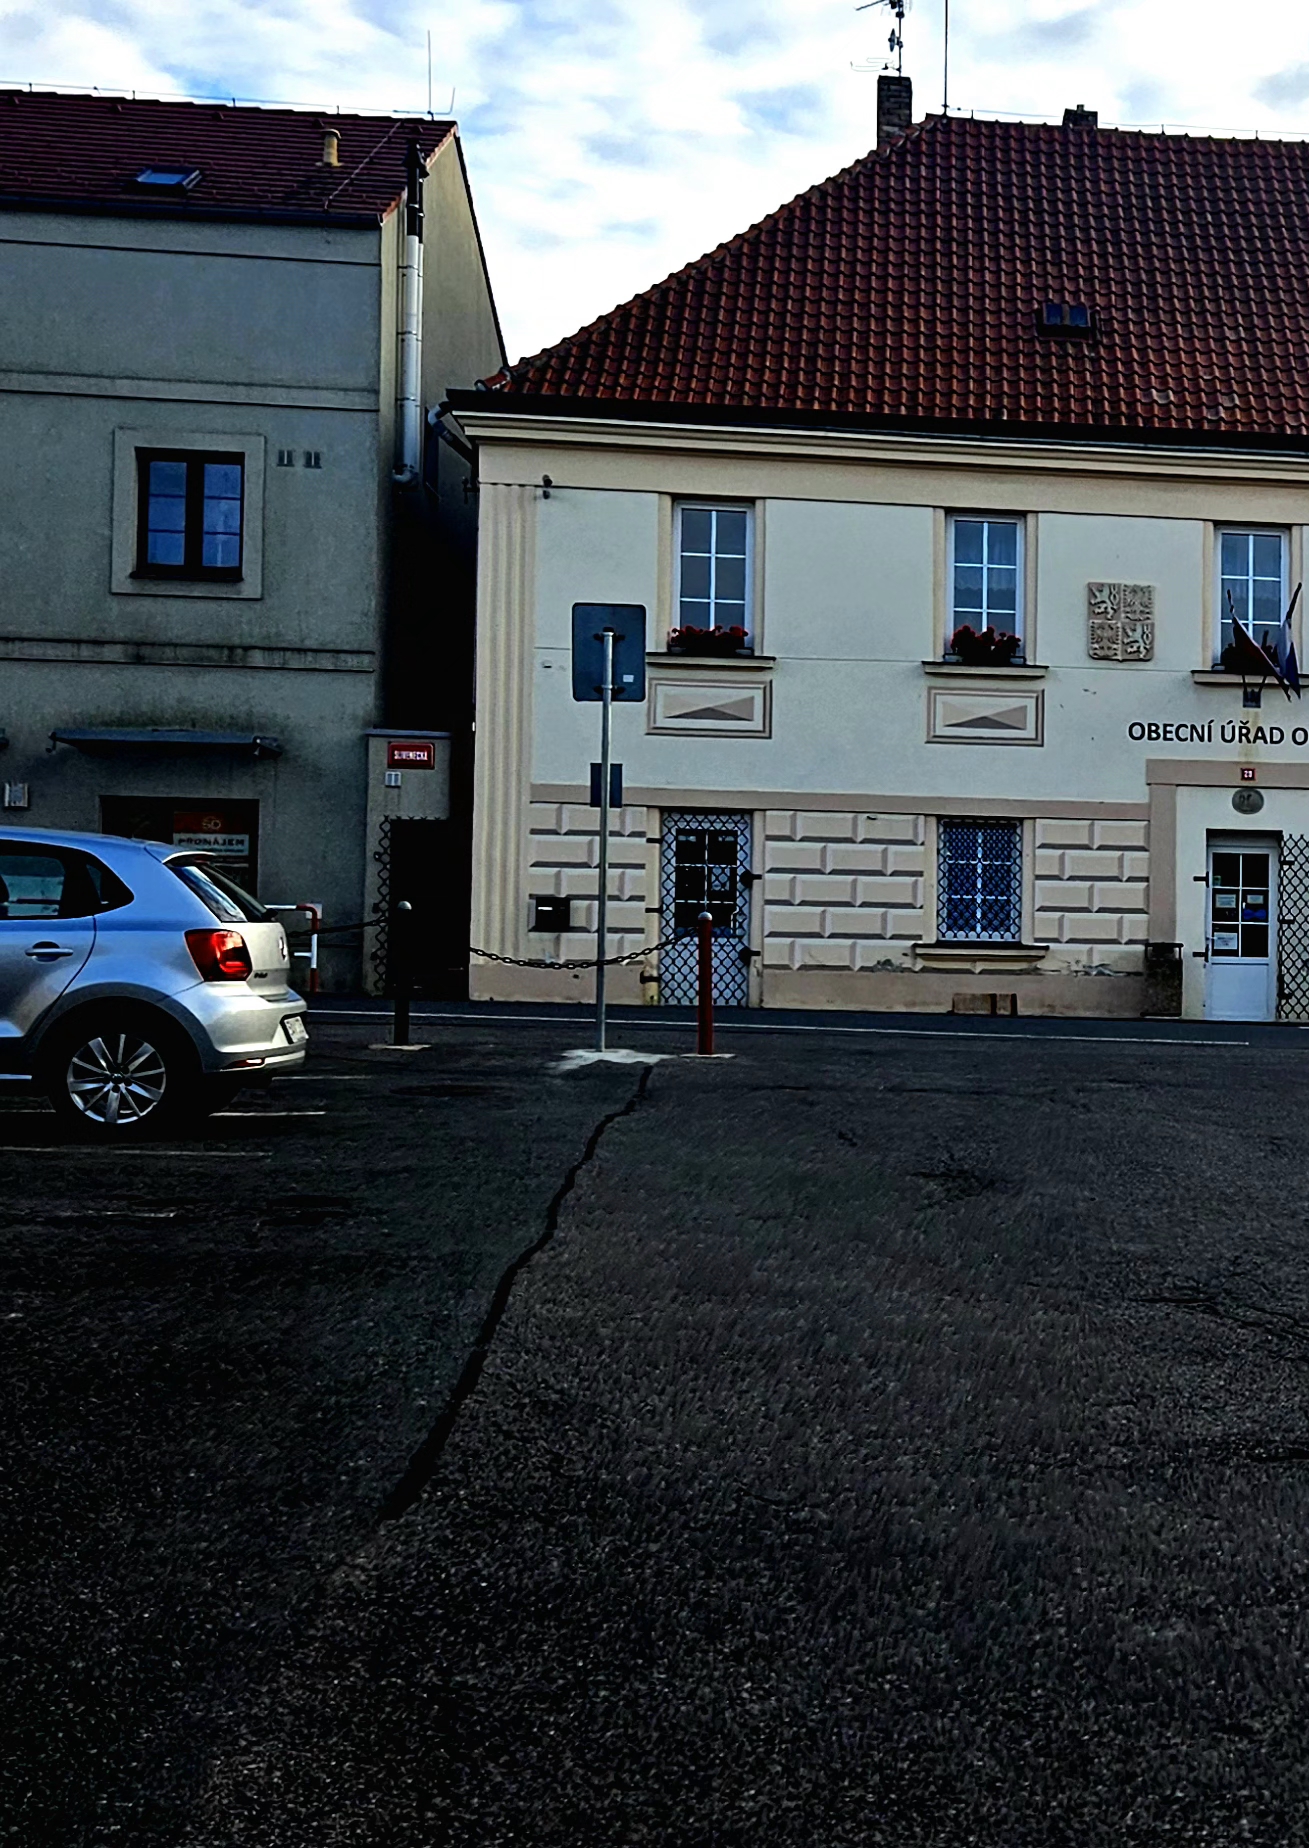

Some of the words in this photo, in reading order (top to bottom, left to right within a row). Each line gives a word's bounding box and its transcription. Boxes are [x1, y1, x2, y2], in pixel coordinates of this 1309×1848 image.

[1128, 719, 1215, 743] OBECNÍ
[1220, 720, 1285, 745] ÚŘAD
[178, 837, 245, 847] PRONÁJEM
